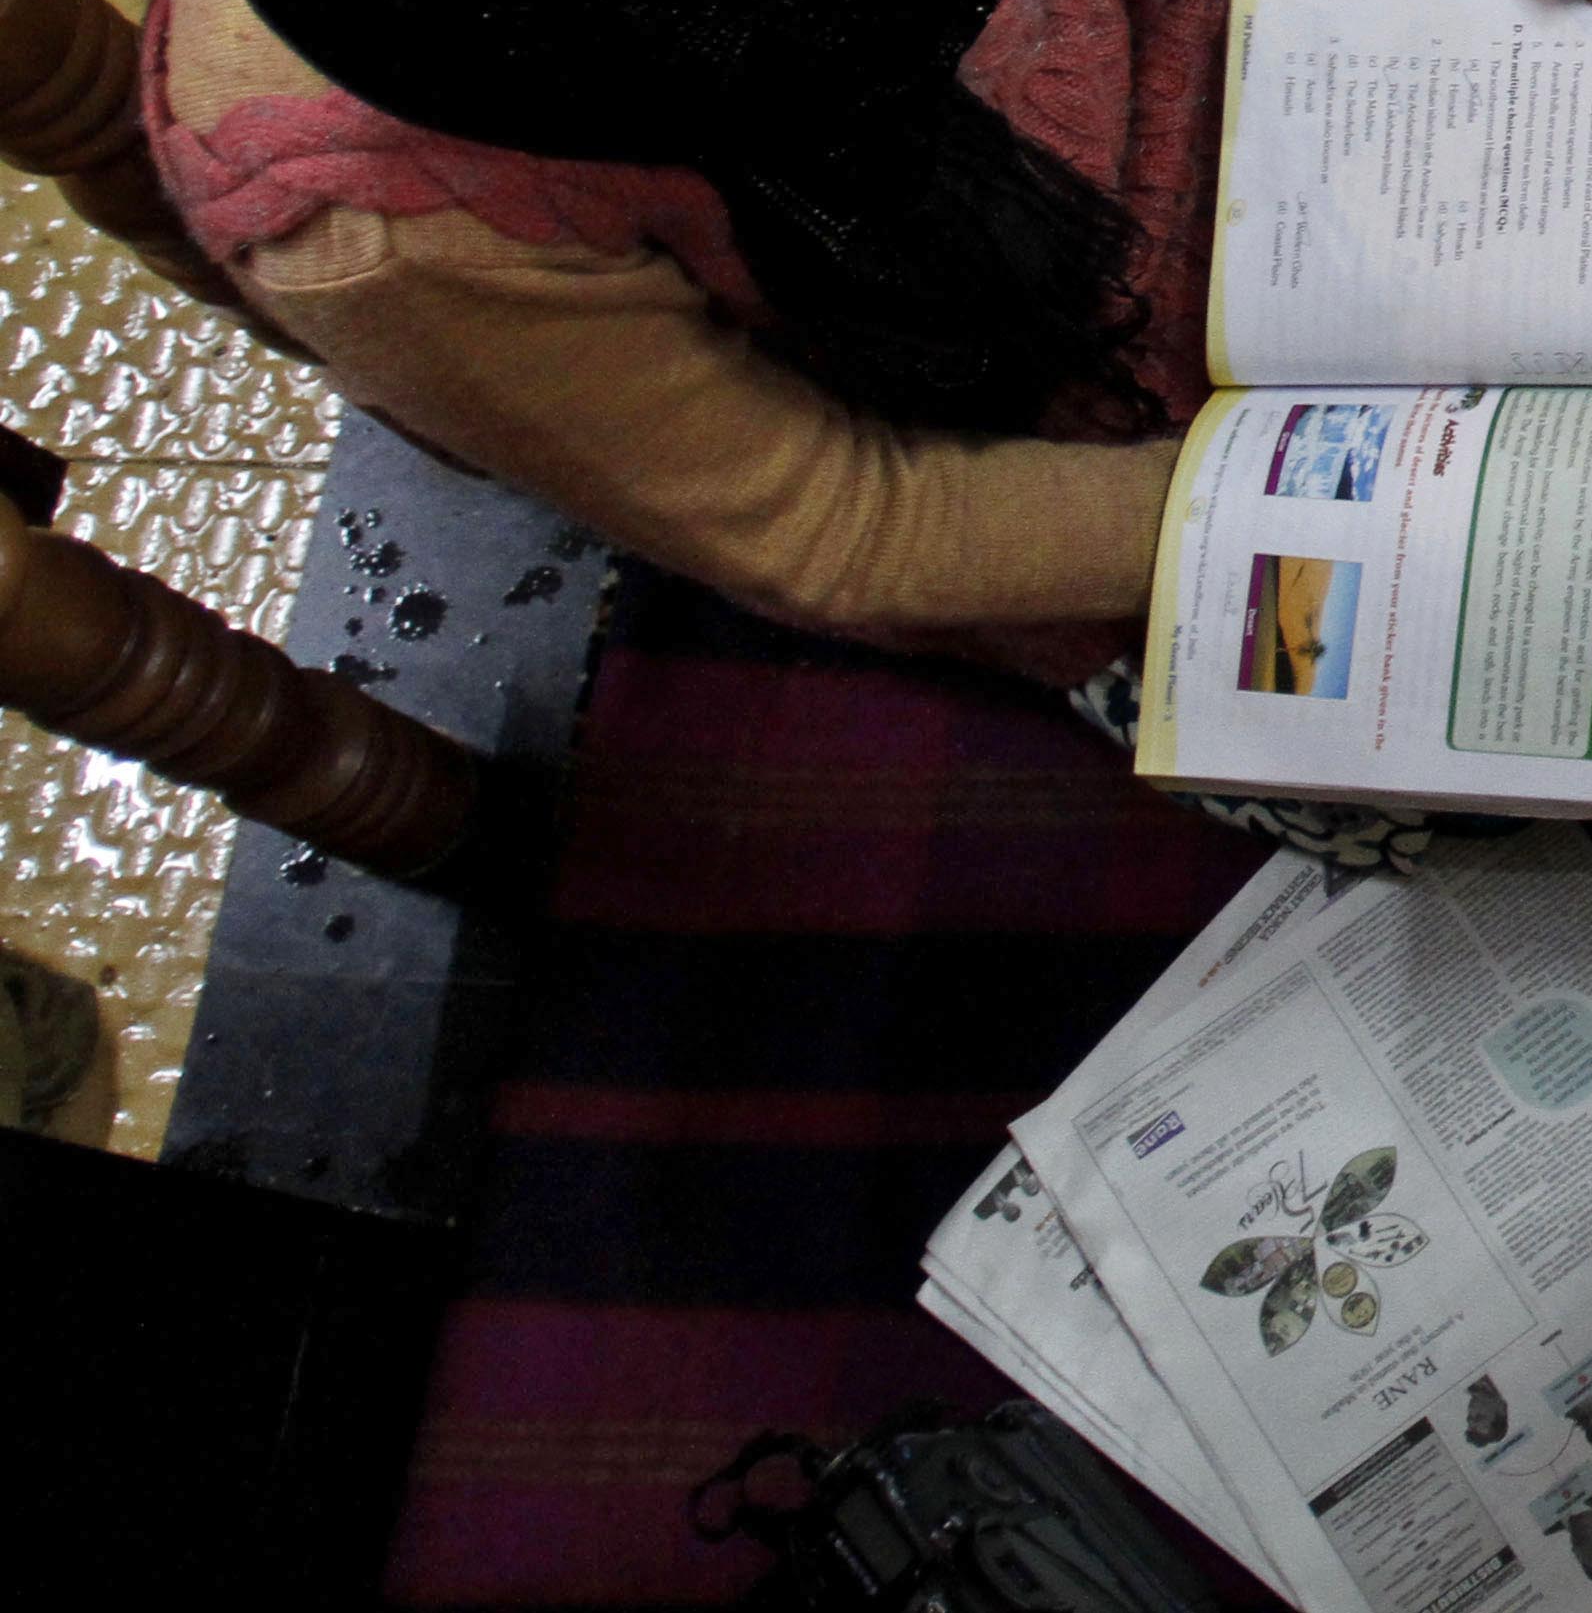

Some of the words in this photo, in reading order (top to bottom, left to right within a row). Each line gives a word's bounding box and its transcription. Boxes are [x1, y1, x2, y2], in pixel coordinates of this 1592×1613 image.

[1243, 14, 1253, 30] PM
[1512, 24, 1523, 36] D.
[1240, 31, 1252, 80] Publishers
[1510, 40, 1522, 59] The
[1507, 62, 1520, 105] multiple
[1504, 107, 1517, 140] choice
[1499, 142, 1513, 193] questions
[1496, 195, 1510, 234] (MCQs)
[1432, 417, 1458, 478] Activities
[1128, 1110, 1183, 1157] Rane
[1371, 1355, 1439, 1413] RANE
